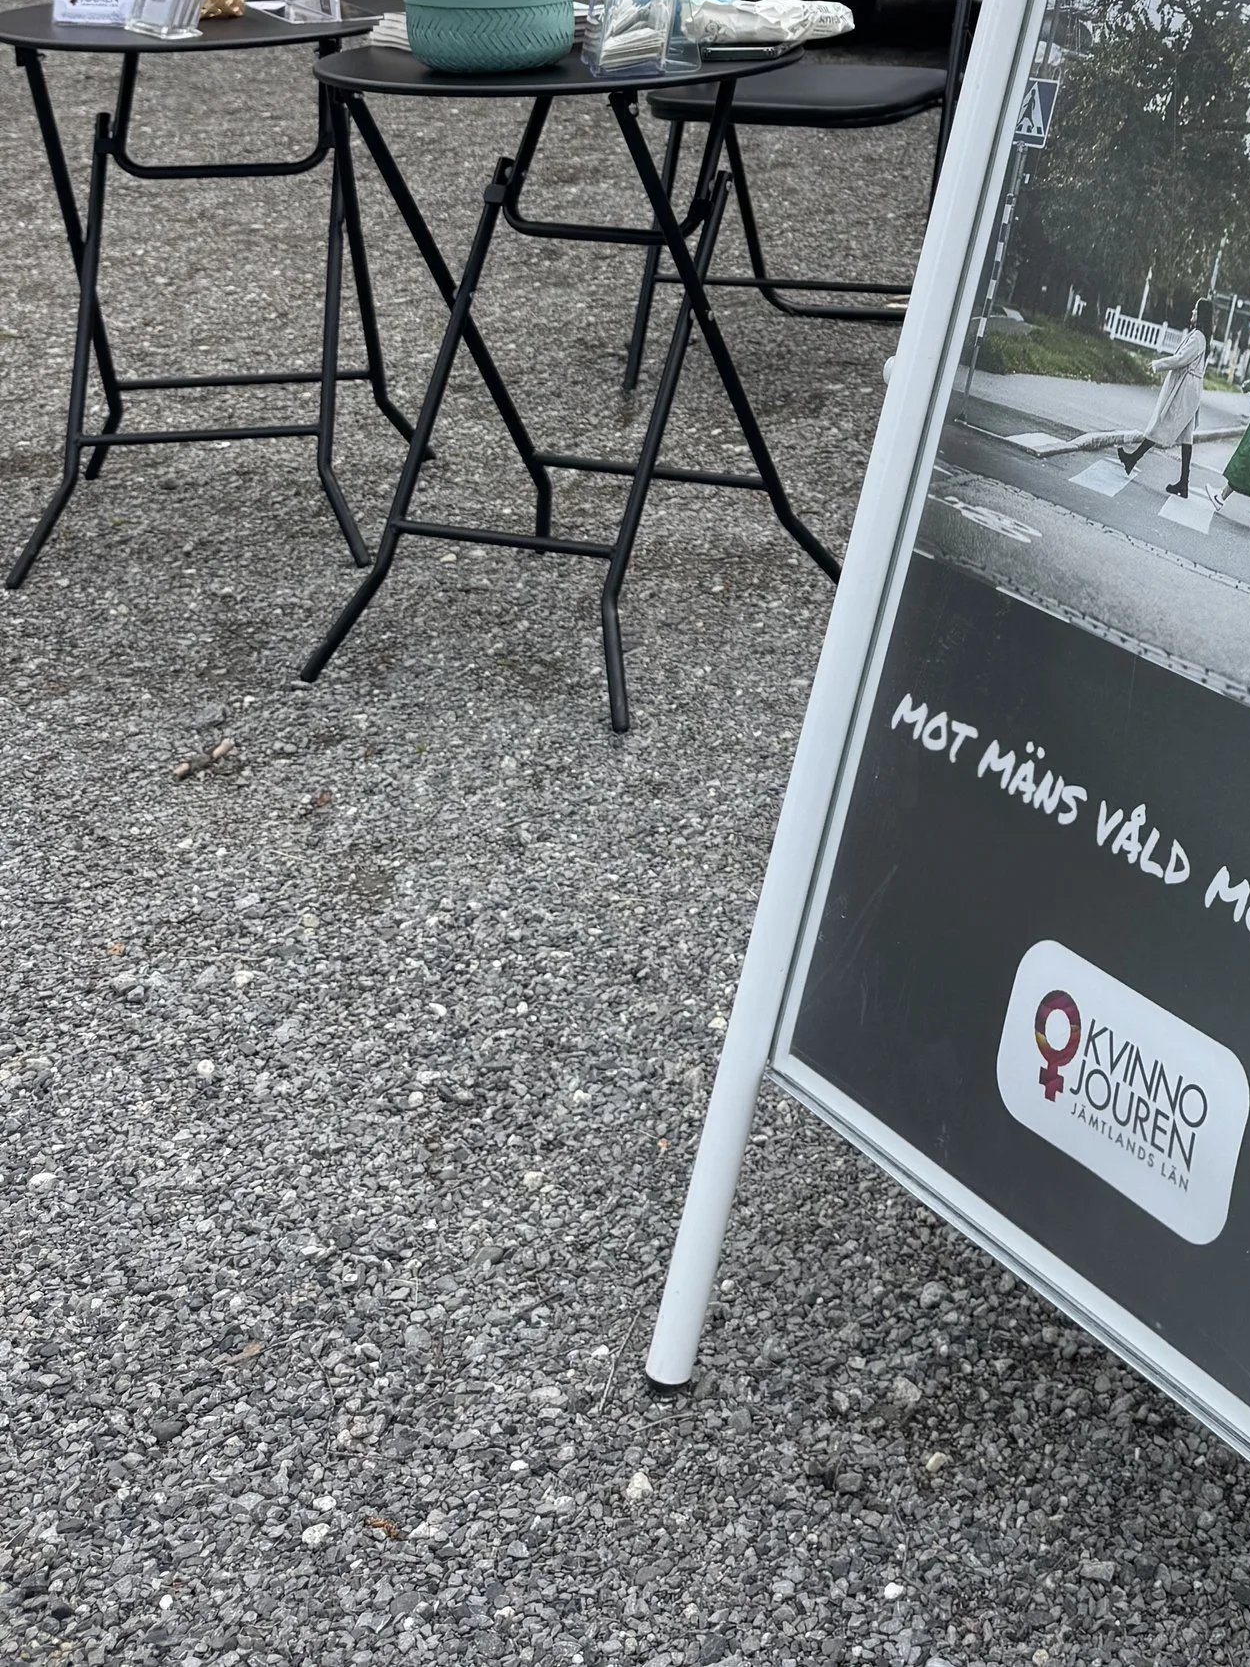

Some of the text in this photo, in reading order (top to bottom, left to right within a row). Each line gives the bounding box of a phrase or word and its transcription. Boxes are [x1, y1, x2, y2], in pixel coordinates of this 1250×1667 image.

[891, 693, 979, 763] MOT
[977, 739, 1088, 825] MÄNS
[1096, 800, 1190, 884] VÅLD
[1069, 1059, 1197, 1173] JOUREN
[1083, 1018, 1208, 1128] KVINNO
[1070, 1102, 1190, 1193] JÄMTLANDS LÄN
